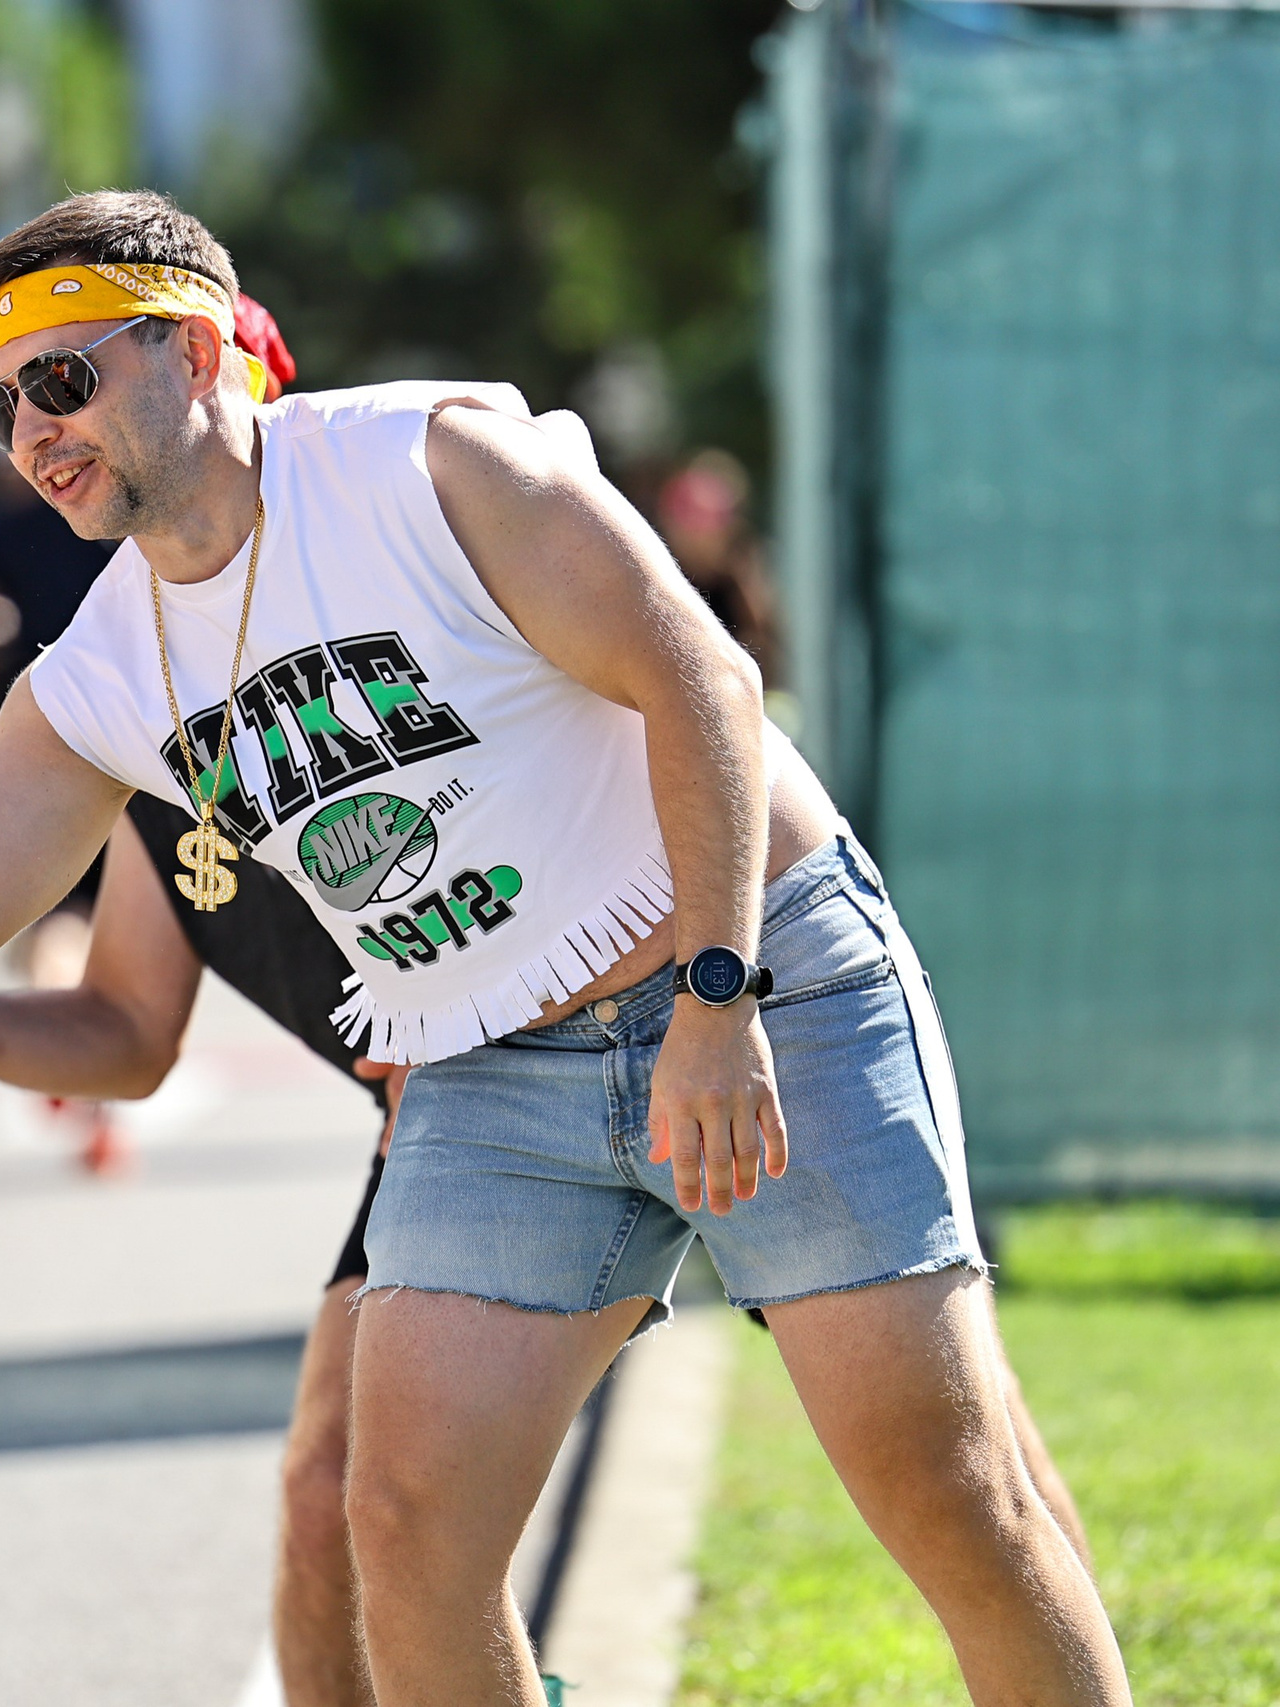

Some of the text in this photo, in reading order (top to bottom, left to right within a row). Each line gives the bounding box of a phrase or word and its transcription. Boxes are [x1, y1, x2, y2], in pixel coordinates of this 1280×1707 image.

[160, 631, 482, 858] NIKE
[308, 795, 406, 881] NIKE
[428, 777, 475, 816] DO IT.
[355, 867, 518, 973] 1972
[712, 960, 726, 992] 11:37
